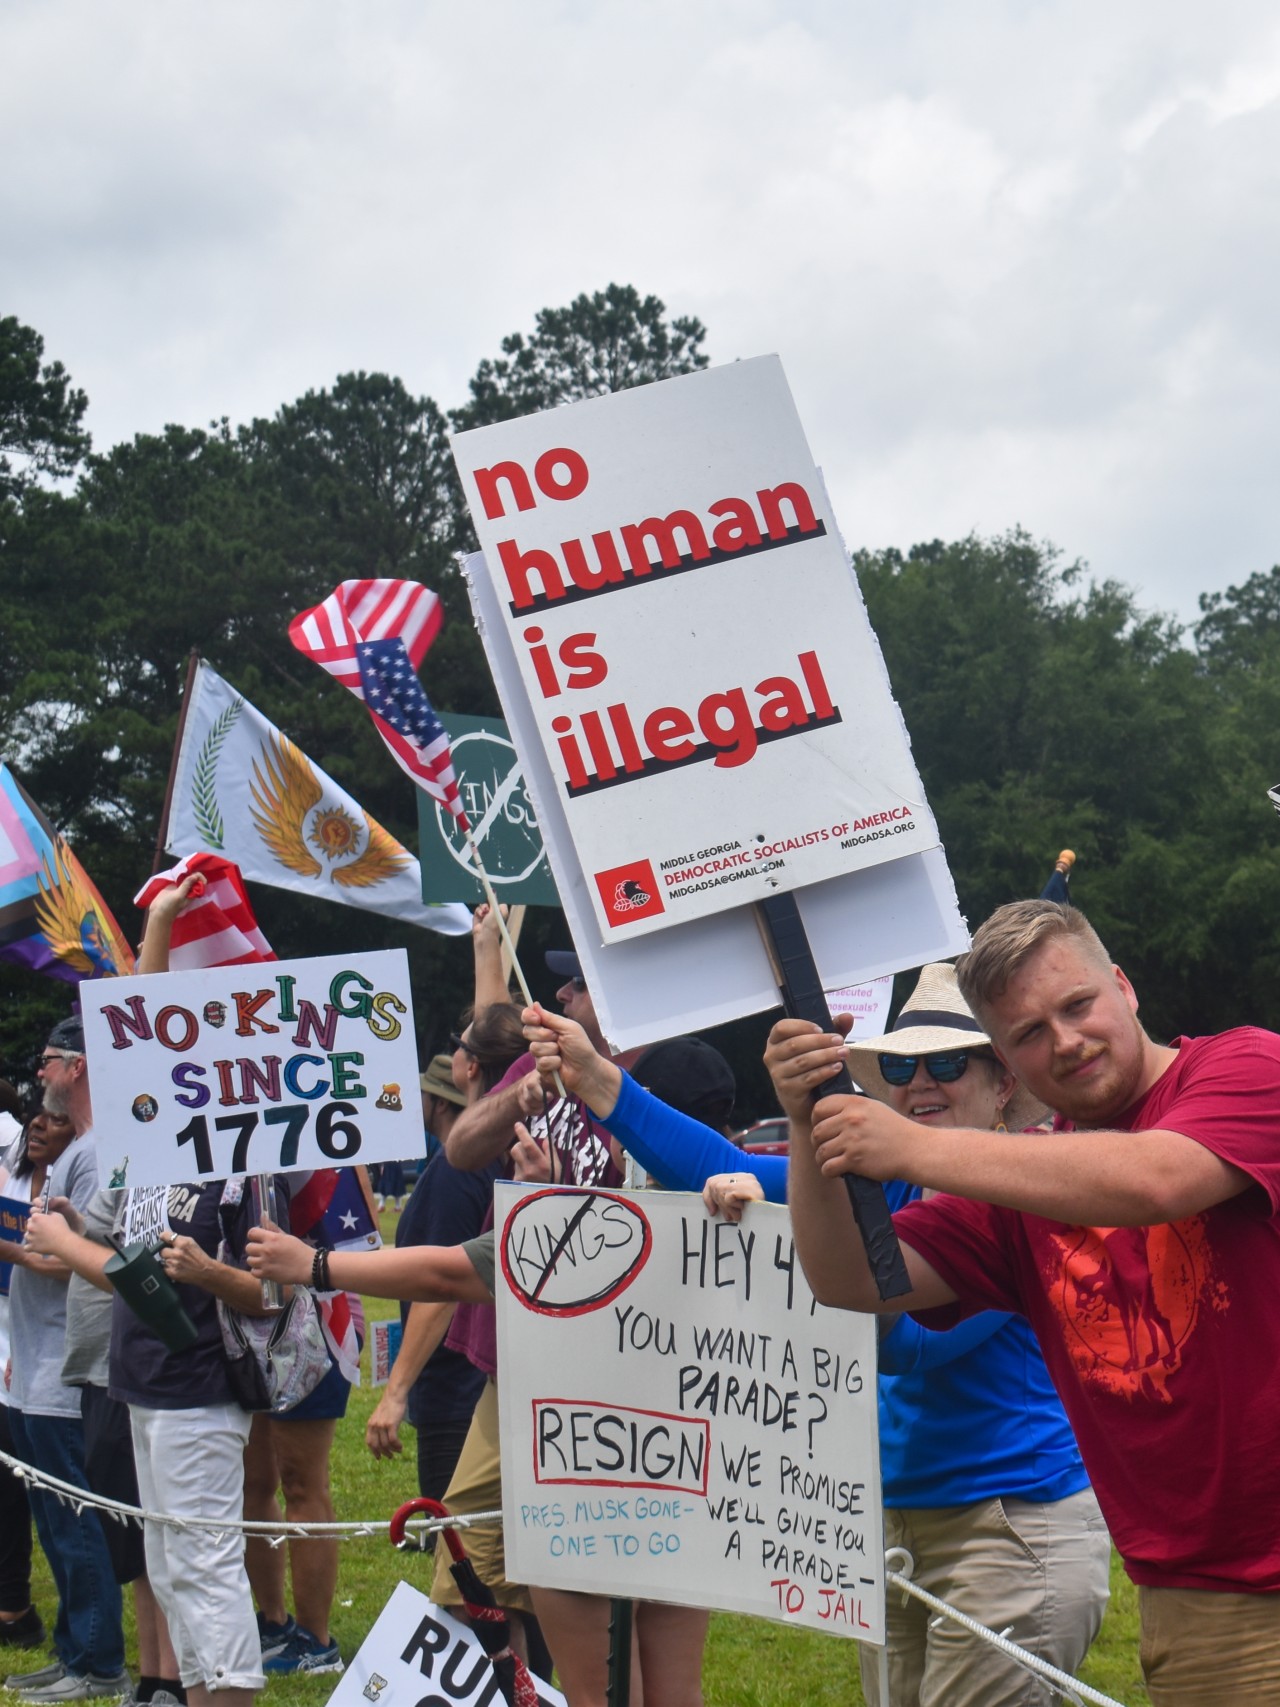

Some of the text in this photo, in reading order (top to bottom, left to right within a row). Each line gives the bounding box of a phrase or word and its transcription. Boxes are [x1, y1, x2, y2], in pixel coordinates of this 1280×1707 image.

[473, 447, 589, 520] no
[496, 481, 819, 610] human
[523, 625, 608, 699] is
[551, 650, 835, 790] illegal
[660, 840, 742, 871] MIDDLE GEORGIA
[664, 806, 912, 886] DEMOCRATIC SOCIALISTS OF AMERICA
[840, 821, 915, 850] MIDGADSA.ORG
[101, 970, 406, 1052] NO KINGS
[171, 1052, 367, 1108] SINCE
[176, 1101, 362, 1174] 1776
[129, 1194, 166, 1238] AGAINST
[510, 1204, 632, 1285] KINGS
[681, 1217, 817, 1317] HEY 4
[615, 1305, 863, 1394] YOU WANT A BIG
[538, 1407, 705, 1481] RESIGN
[679, 1365, 827, 1460] PARADE?
[521, 1498, 694, 1528] PRES. MUSK GONE-
[721, 1441, 866, 1516] WE PROMISE
[549, 1533, 681, 1558] ONE TO GO
[705, 1497, 866, 1555] WE'LL GIVE YOU
[725, 1530, 741, 1560] A
[771, 1579, 870, 1630] TO JAIL
